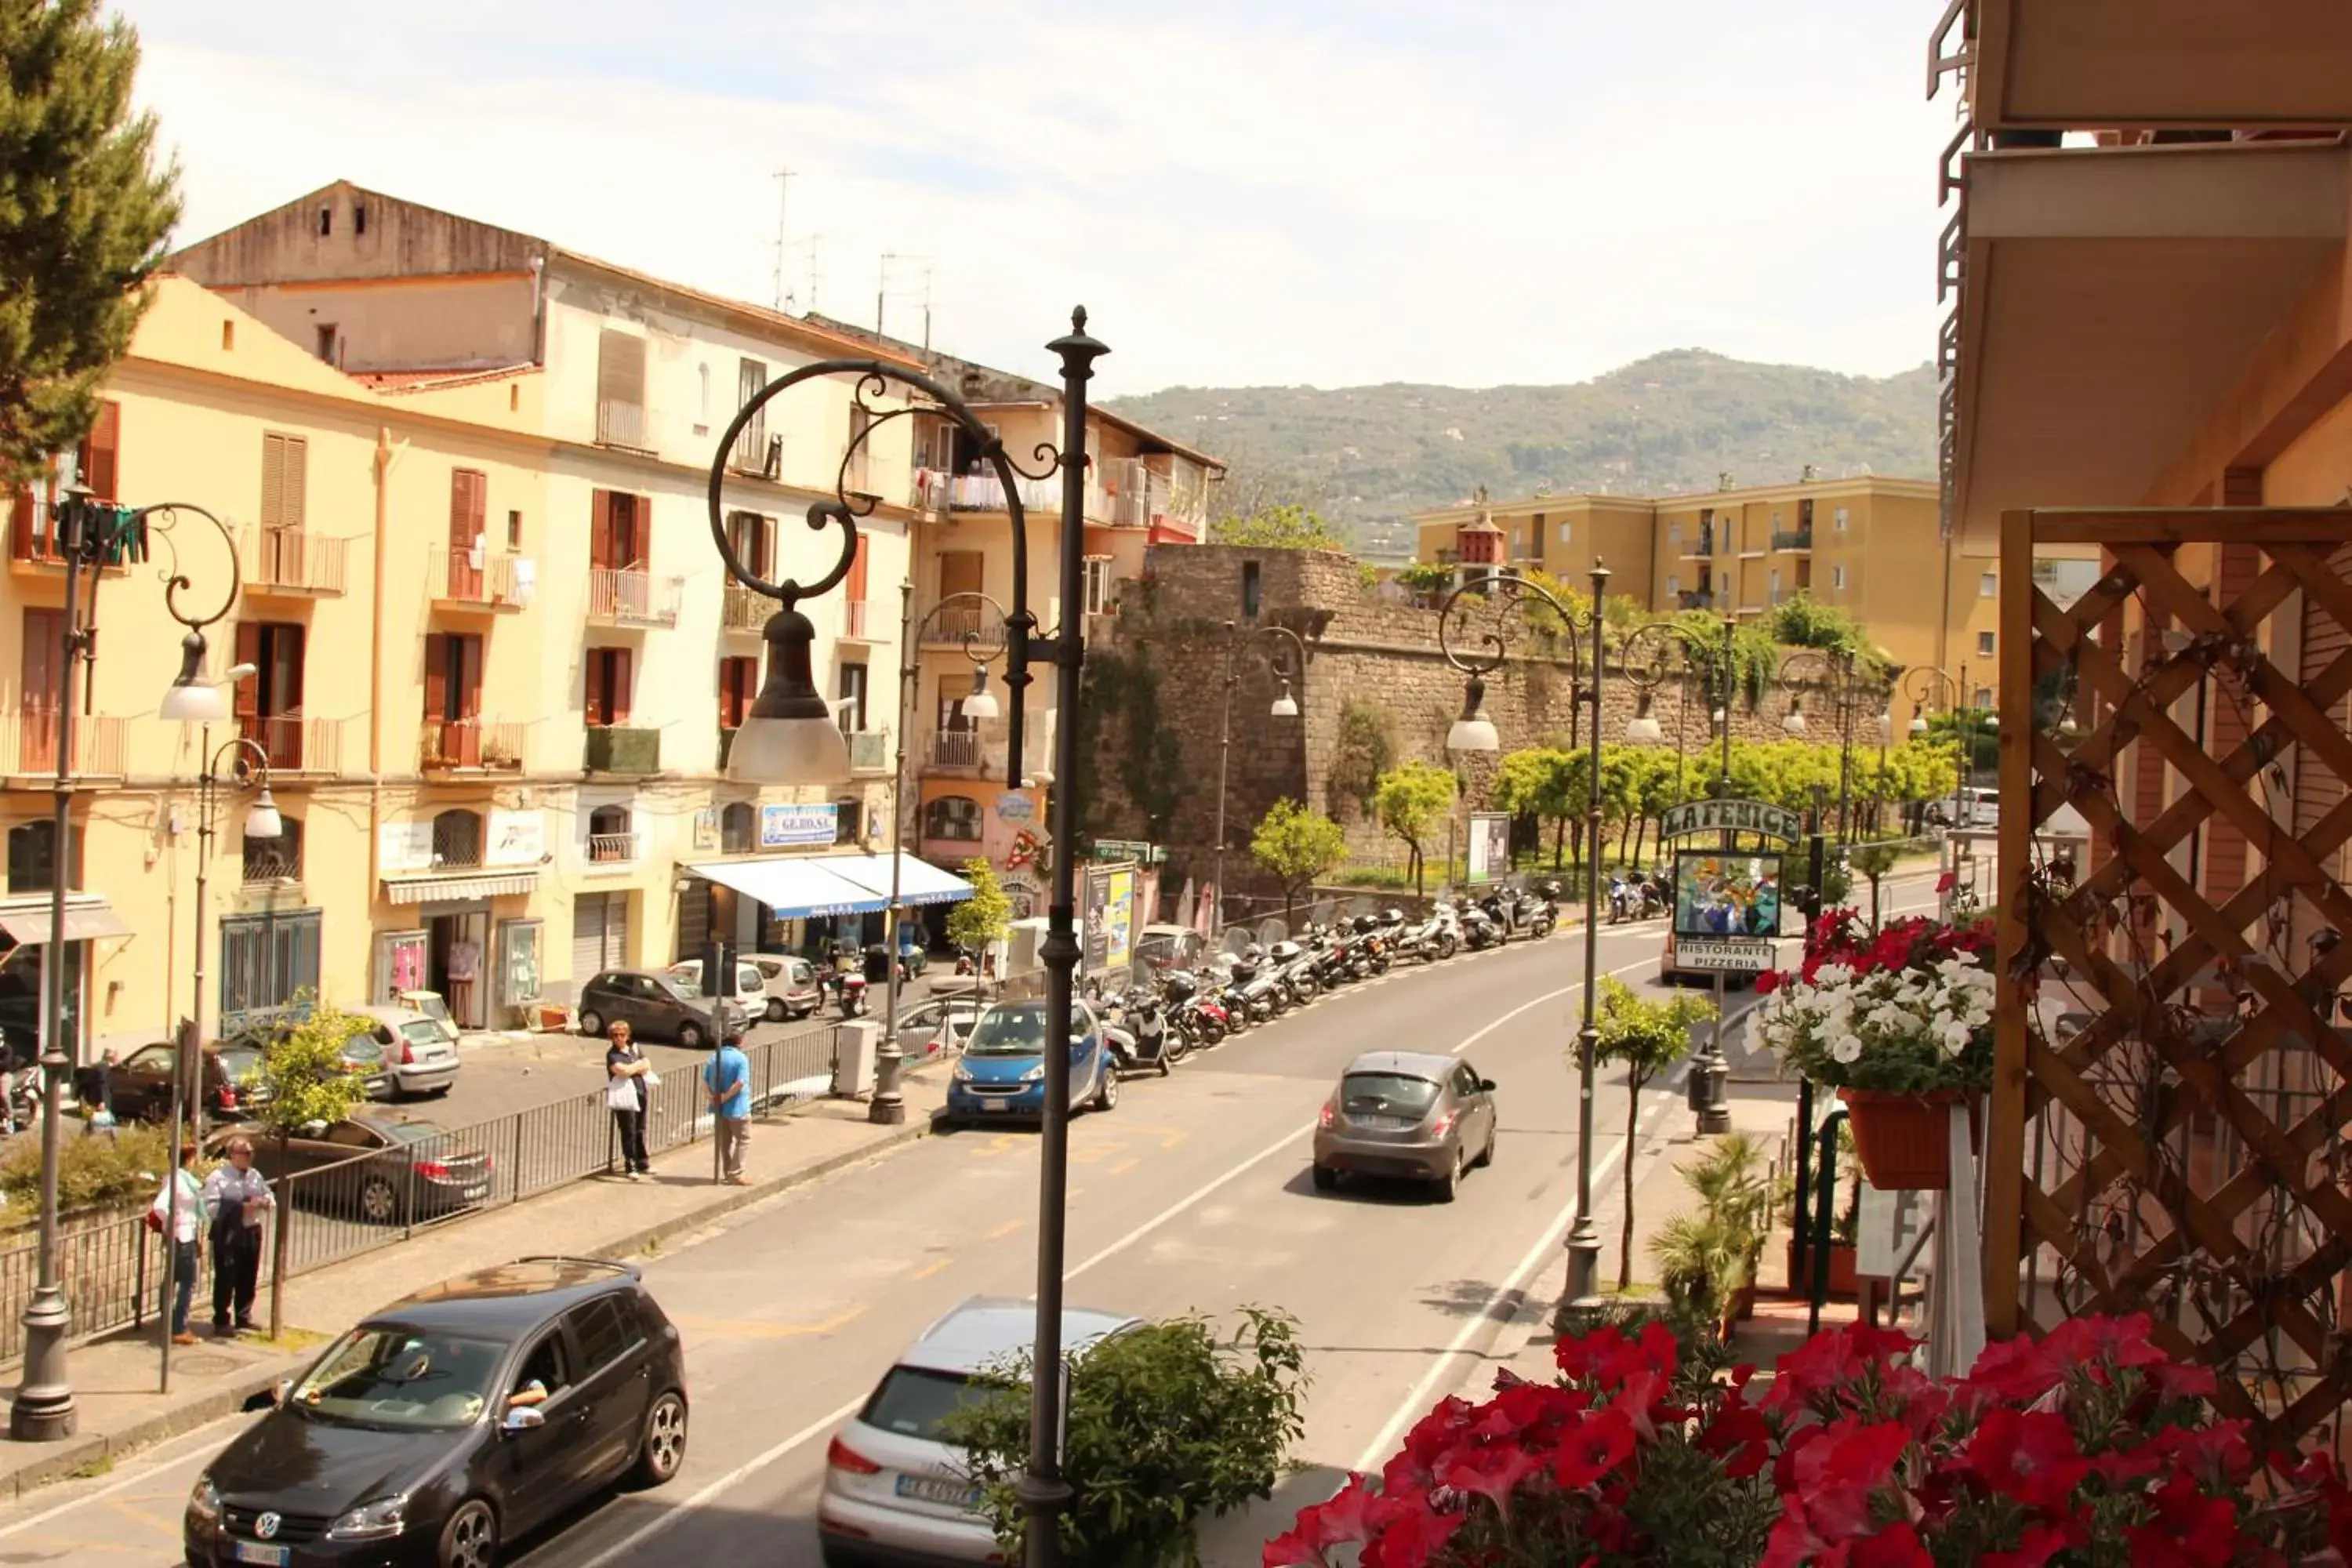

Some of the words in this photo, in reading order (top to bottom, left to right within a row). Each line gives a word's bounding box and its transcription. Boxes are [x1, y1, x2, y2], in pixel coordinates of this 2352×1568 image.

[1702, 803, 1798, 841] FENICE
[1679, 943, 1769, 956] RISTORANTE
[1694, 957, 1759, 969] PIZZERIA
